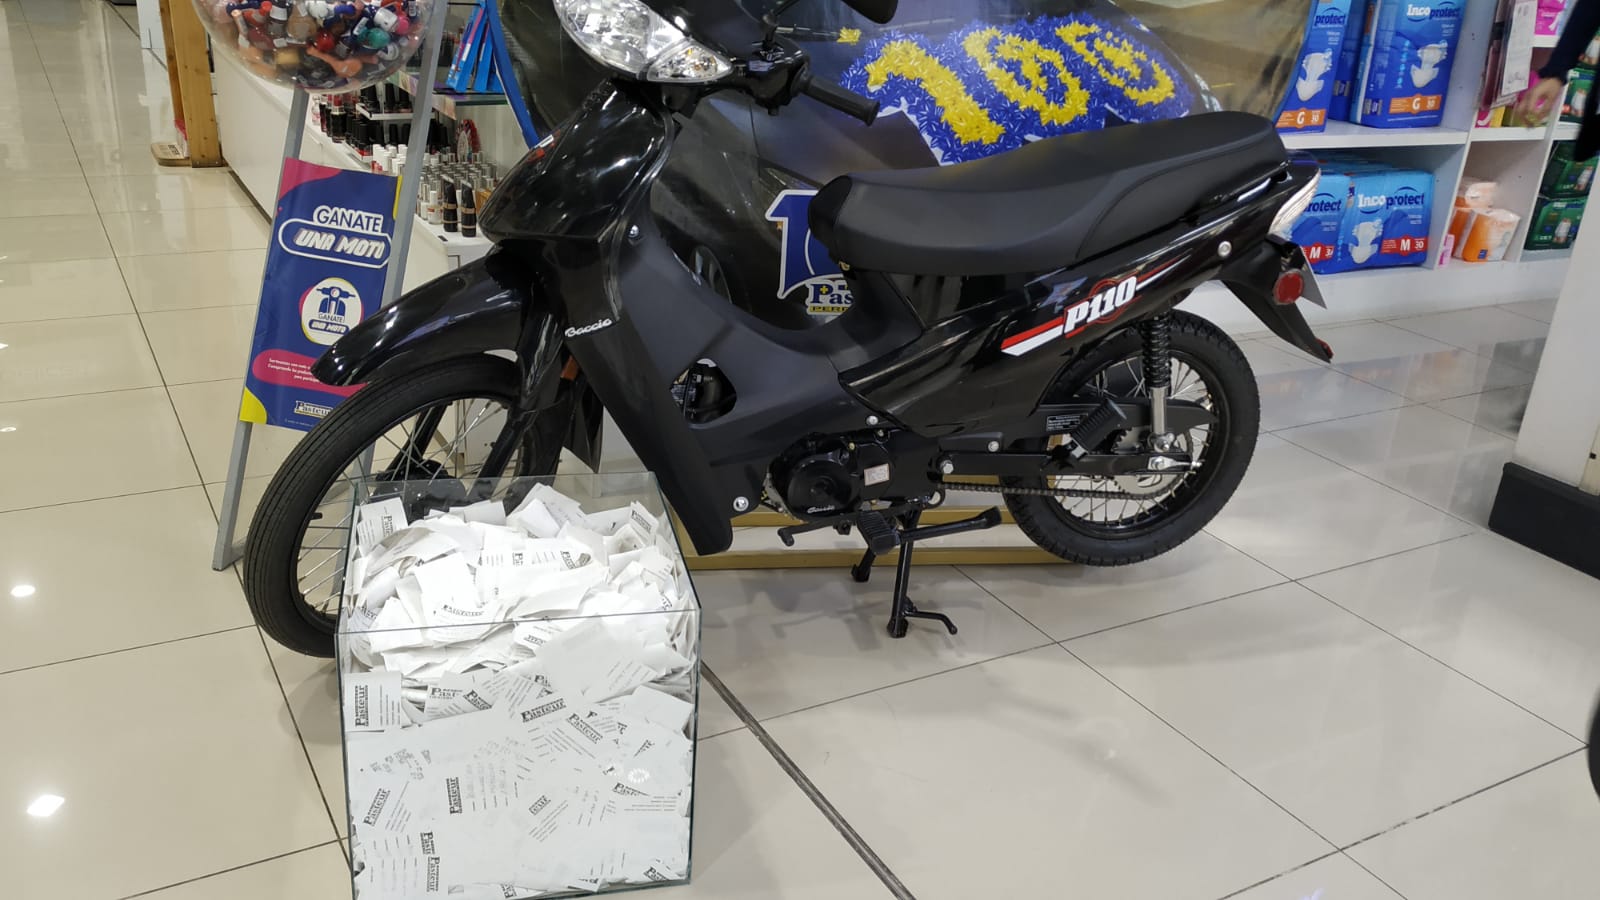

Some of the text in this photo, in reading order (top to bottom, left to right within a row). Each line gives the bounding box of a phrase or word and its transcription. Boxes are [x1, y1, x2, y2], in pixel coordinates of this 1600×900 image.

[1412, 97, 1421, 110] G
[1296, 111, 1305, 125] G
[1358, 193, 1424, 209] Incoprotect
[317, 208, 381, 232] GANATE
[294, 229, 385, 259] UNA MOTO
[1309, 246, 1321, 259] M
[1400, 239, 1411, 251] M
[1414, 239, 1424, 249] 30
[810, 283, 854, 305] Pas
[1064, 276, 1137, 334] P110
[296, 402, 332, 415] Pasteur
[355, 685, 366, 726] Pasteur
[521, 701, 566, 721] Pasteur
[569, 713, 601, 743] Pasteur
[363, 789, 387, 825] Pasteur
[450, 777, 459, 814] Pasteur
[430, 857, 440, 891] Pasteur
